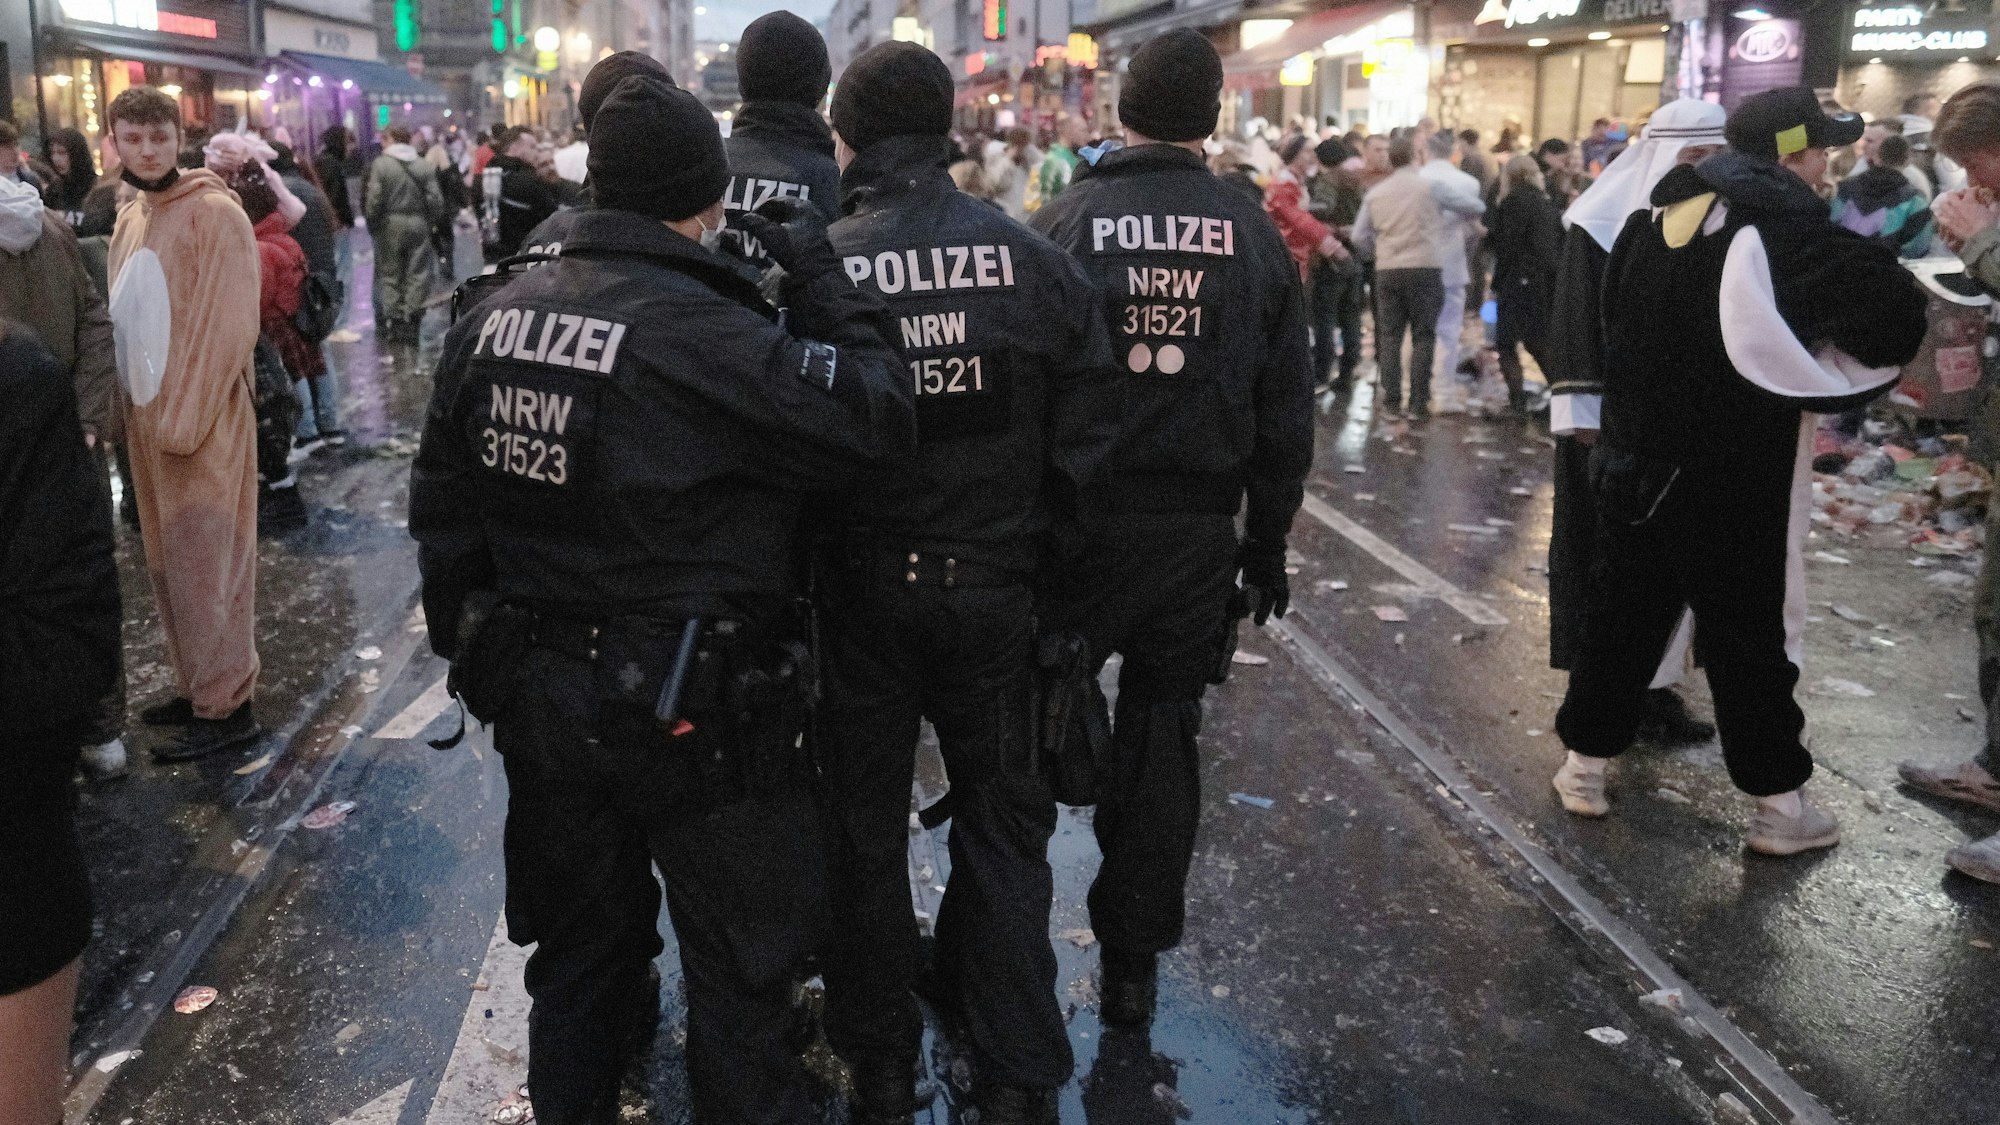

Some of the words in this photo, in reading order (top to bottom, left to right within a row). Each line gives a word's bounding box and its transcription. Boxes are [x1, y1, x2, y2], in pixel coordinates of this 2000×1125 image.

[1093, 215, 1235, 255] POLIZEI
[843, 245, 1015, 294] POLIZEI
[1127, 266, 1204, 299] NRW
[900, 311, 966, 348] NRW
[1123, 304, 1202, 336] 31521
[474, 307, 627, 374] POLIZEI
[910, 355, 983, 395] 1521
[490, 384, 573, 435] NRW
[482, 427, 568, 485] 31523
